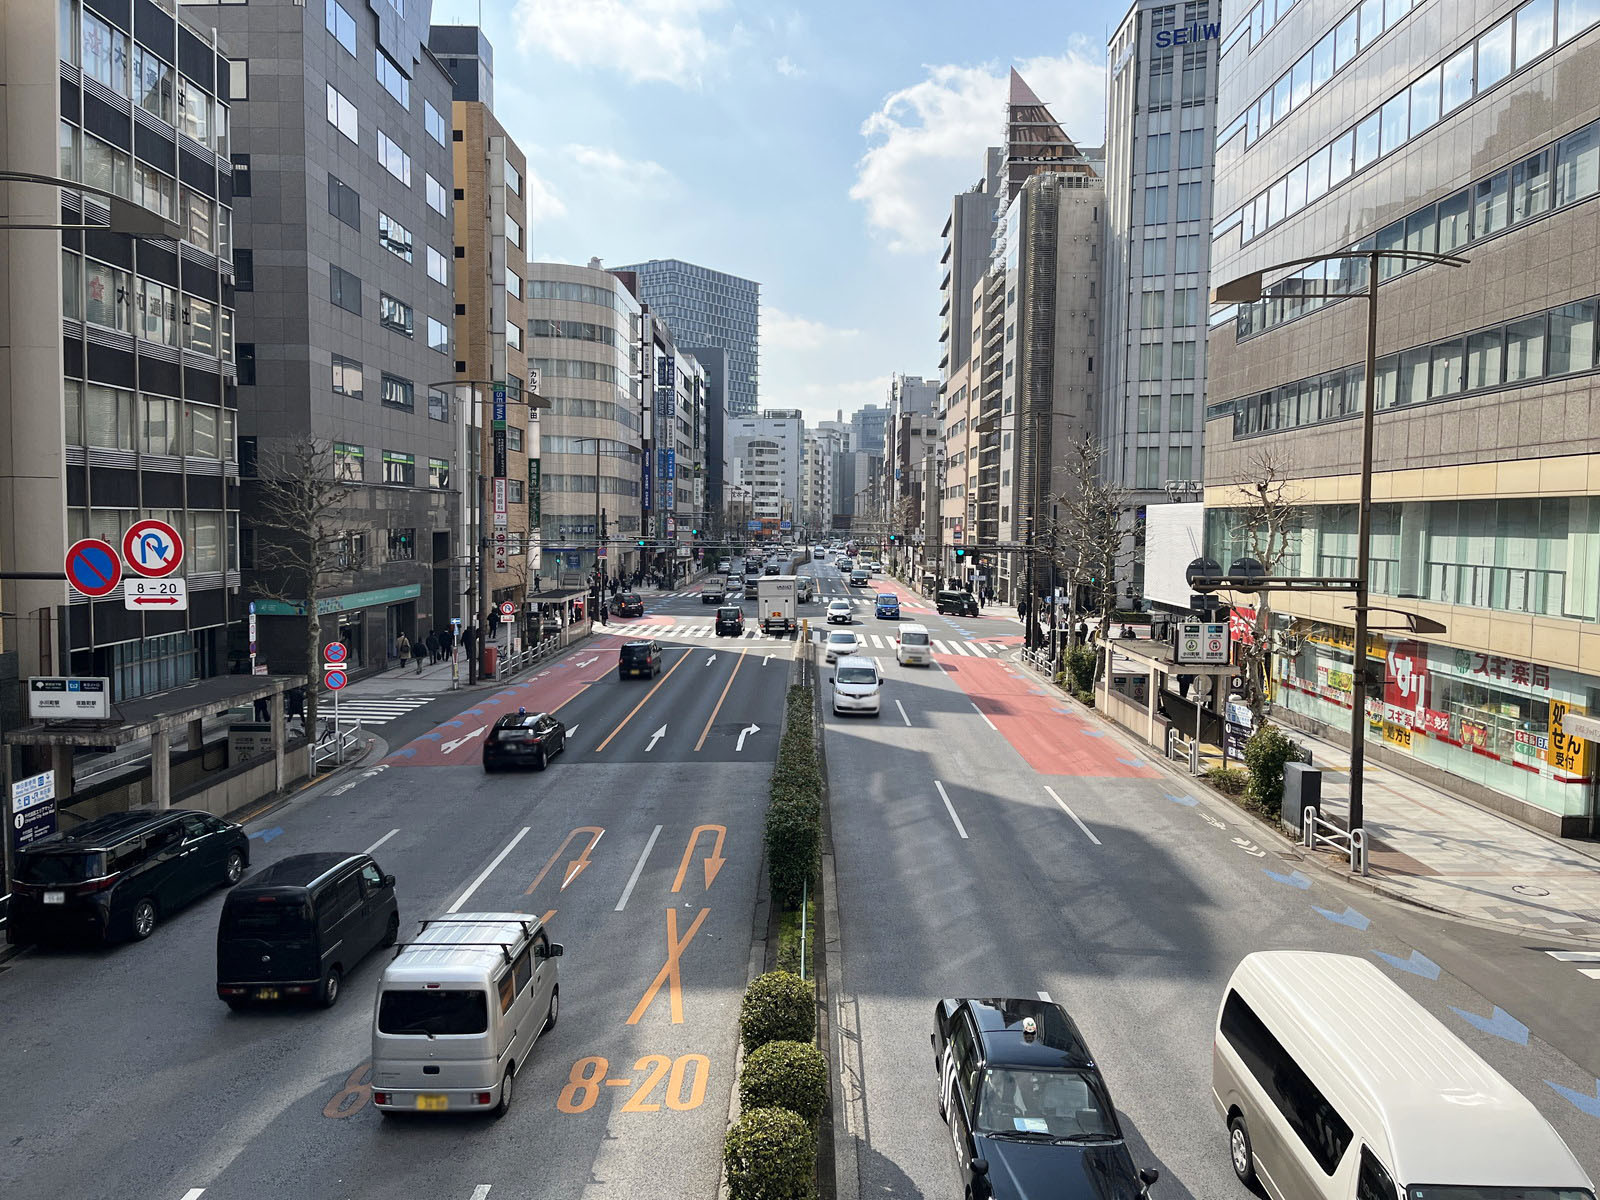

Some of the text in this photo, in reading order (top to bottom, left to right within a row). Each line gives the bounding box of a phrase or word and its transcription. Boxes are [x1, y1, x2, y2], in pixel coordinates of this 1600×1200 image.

[1388, 641, 1425, 707] くすり
[1473, 652, 1550, 690] スギ薬局
[1555, 751, 1574, 770] 受付
[556, 1053, 711, 1114] 8-20
